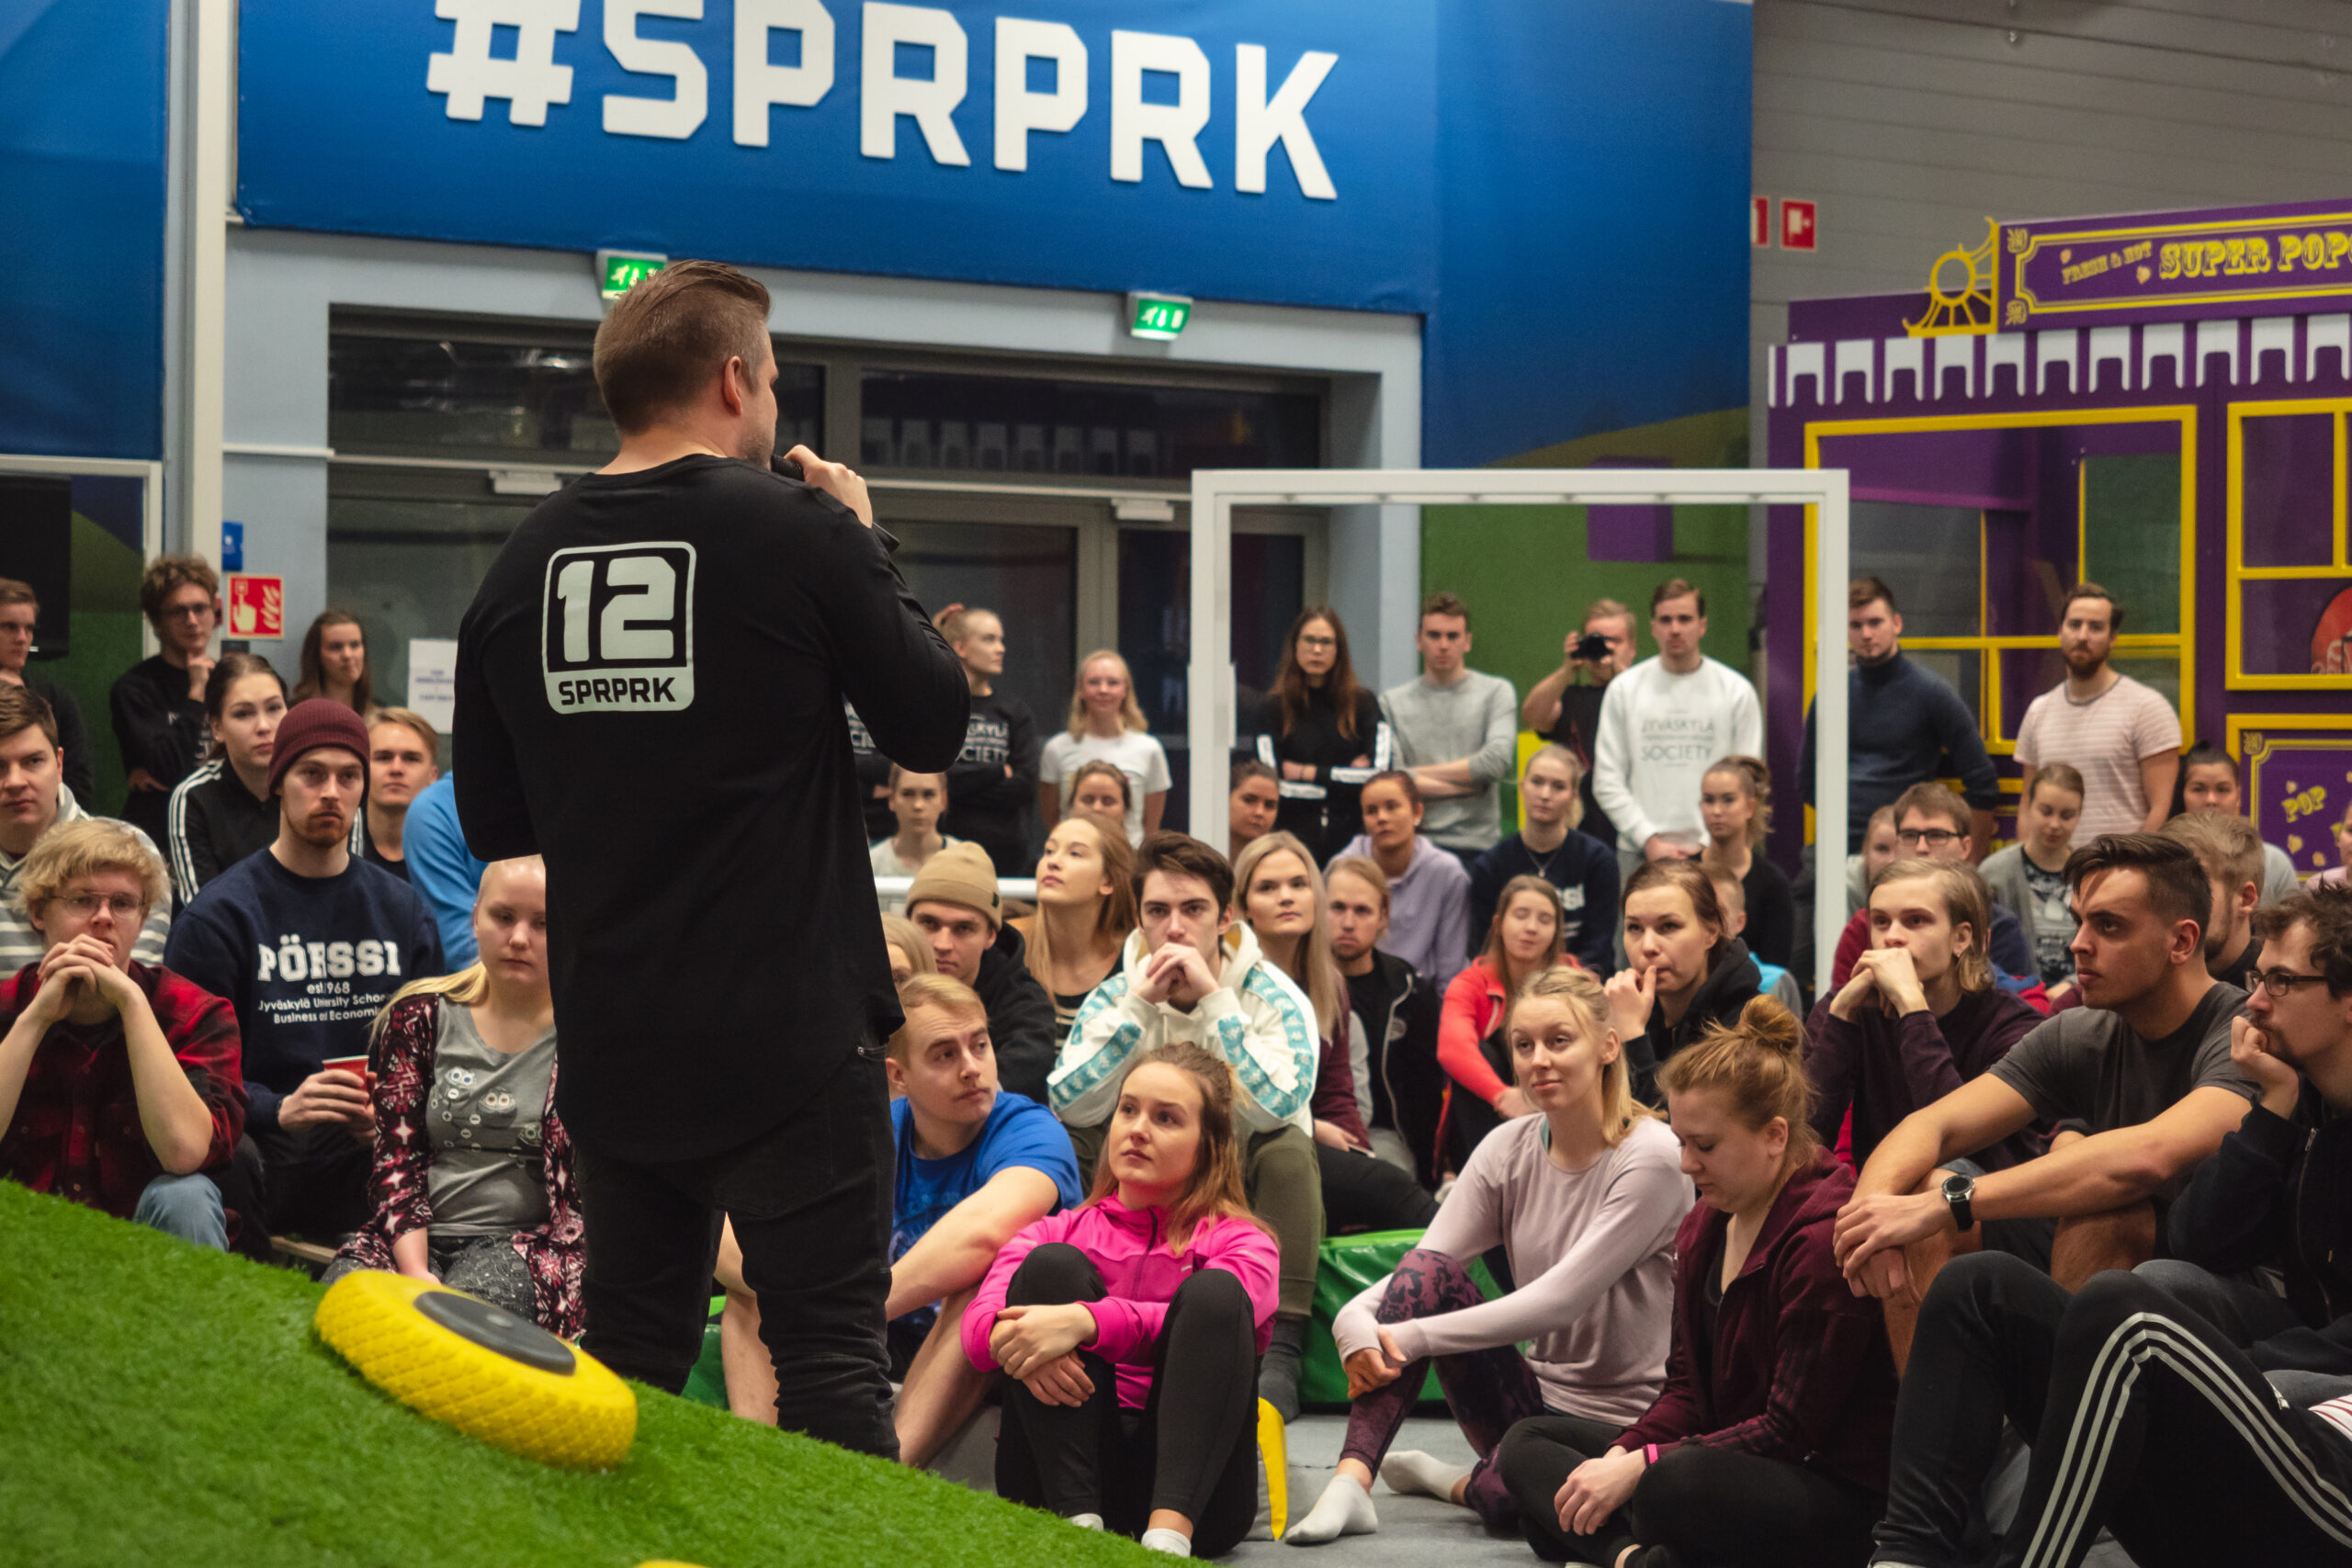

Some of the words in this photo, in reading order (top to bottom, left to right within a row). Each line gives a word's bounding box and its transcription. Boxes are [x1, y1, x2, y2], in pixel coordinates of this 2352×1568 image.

[426, 0, 1339, 200] #SPRPRK
[2159, 237, 2271, 280] SUPER
[2277, 231, 2352, 273] POP
[557, 556, 676, 662] 12
[558, 676, 676, 705] SPRPRK
